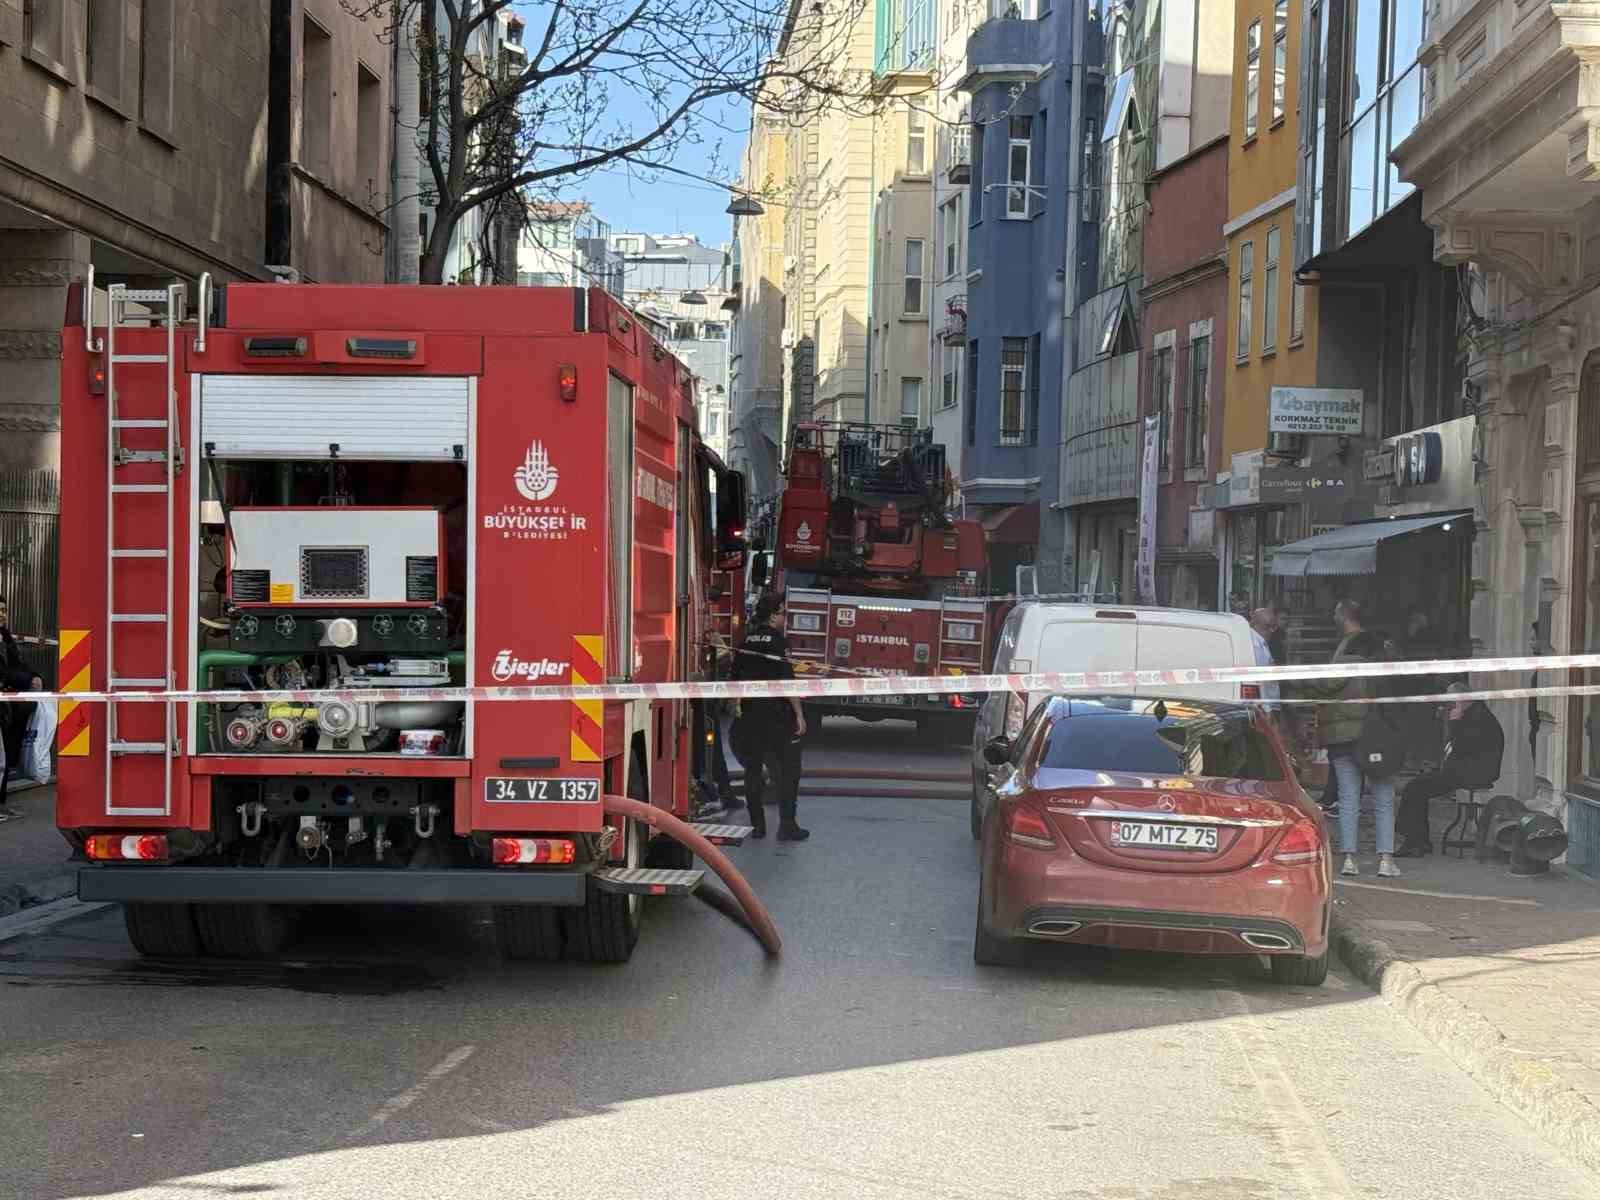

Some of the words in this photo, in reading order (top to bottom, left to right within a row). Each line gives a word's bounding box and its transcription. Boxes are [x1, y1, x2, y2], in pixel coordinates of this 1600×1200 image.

[1274, 415, 1320, 424] KORKMAZ
[1322, 415, 1358, 425] TEKNİK
[503, 504, 568, 514] İSTANBUL
[503, 531, 568, 540] BLEDİYESİ
[856, 634, 910, 647] İSTANBUL
[491, 649, 570, 682] Ziegler
[495, 780, 516, 799] 34
[527, 780, 549, 799] VZ
[560, 781, 598, 800] 1357
[1121, 824, 1143, 841] 07
[1149, 824, 1188, 844] MTZ
[1195, 828, 1216, 846] 75
